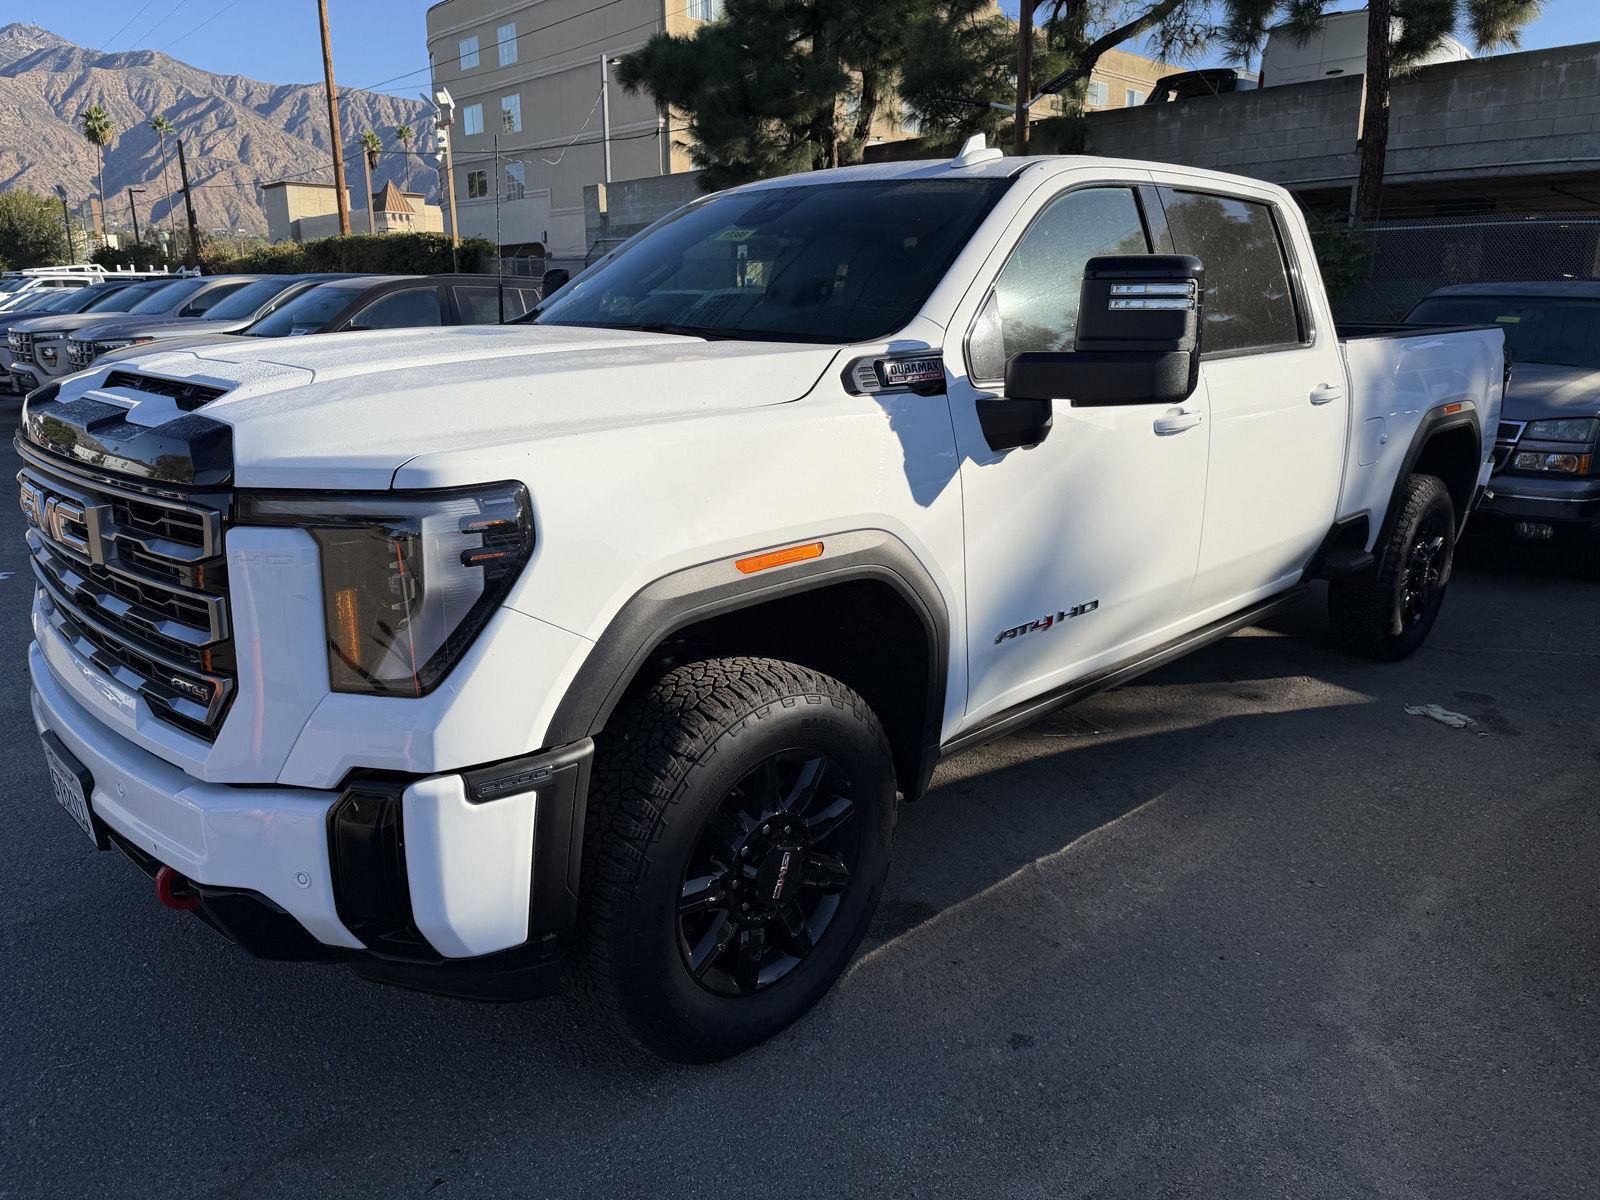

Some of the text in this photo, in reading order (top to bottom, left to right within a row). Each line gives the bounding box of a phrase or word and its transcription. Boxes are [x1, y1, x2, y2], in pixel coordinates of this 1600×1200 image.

[890, 361, 940, 375] DURAMAX
[20, 481, 91, 556] GMC
[994, 599, 1099, 645] AT4 HD
[170, 677, 209, 701] AT4
[772, 851, 791, 899] GMC
